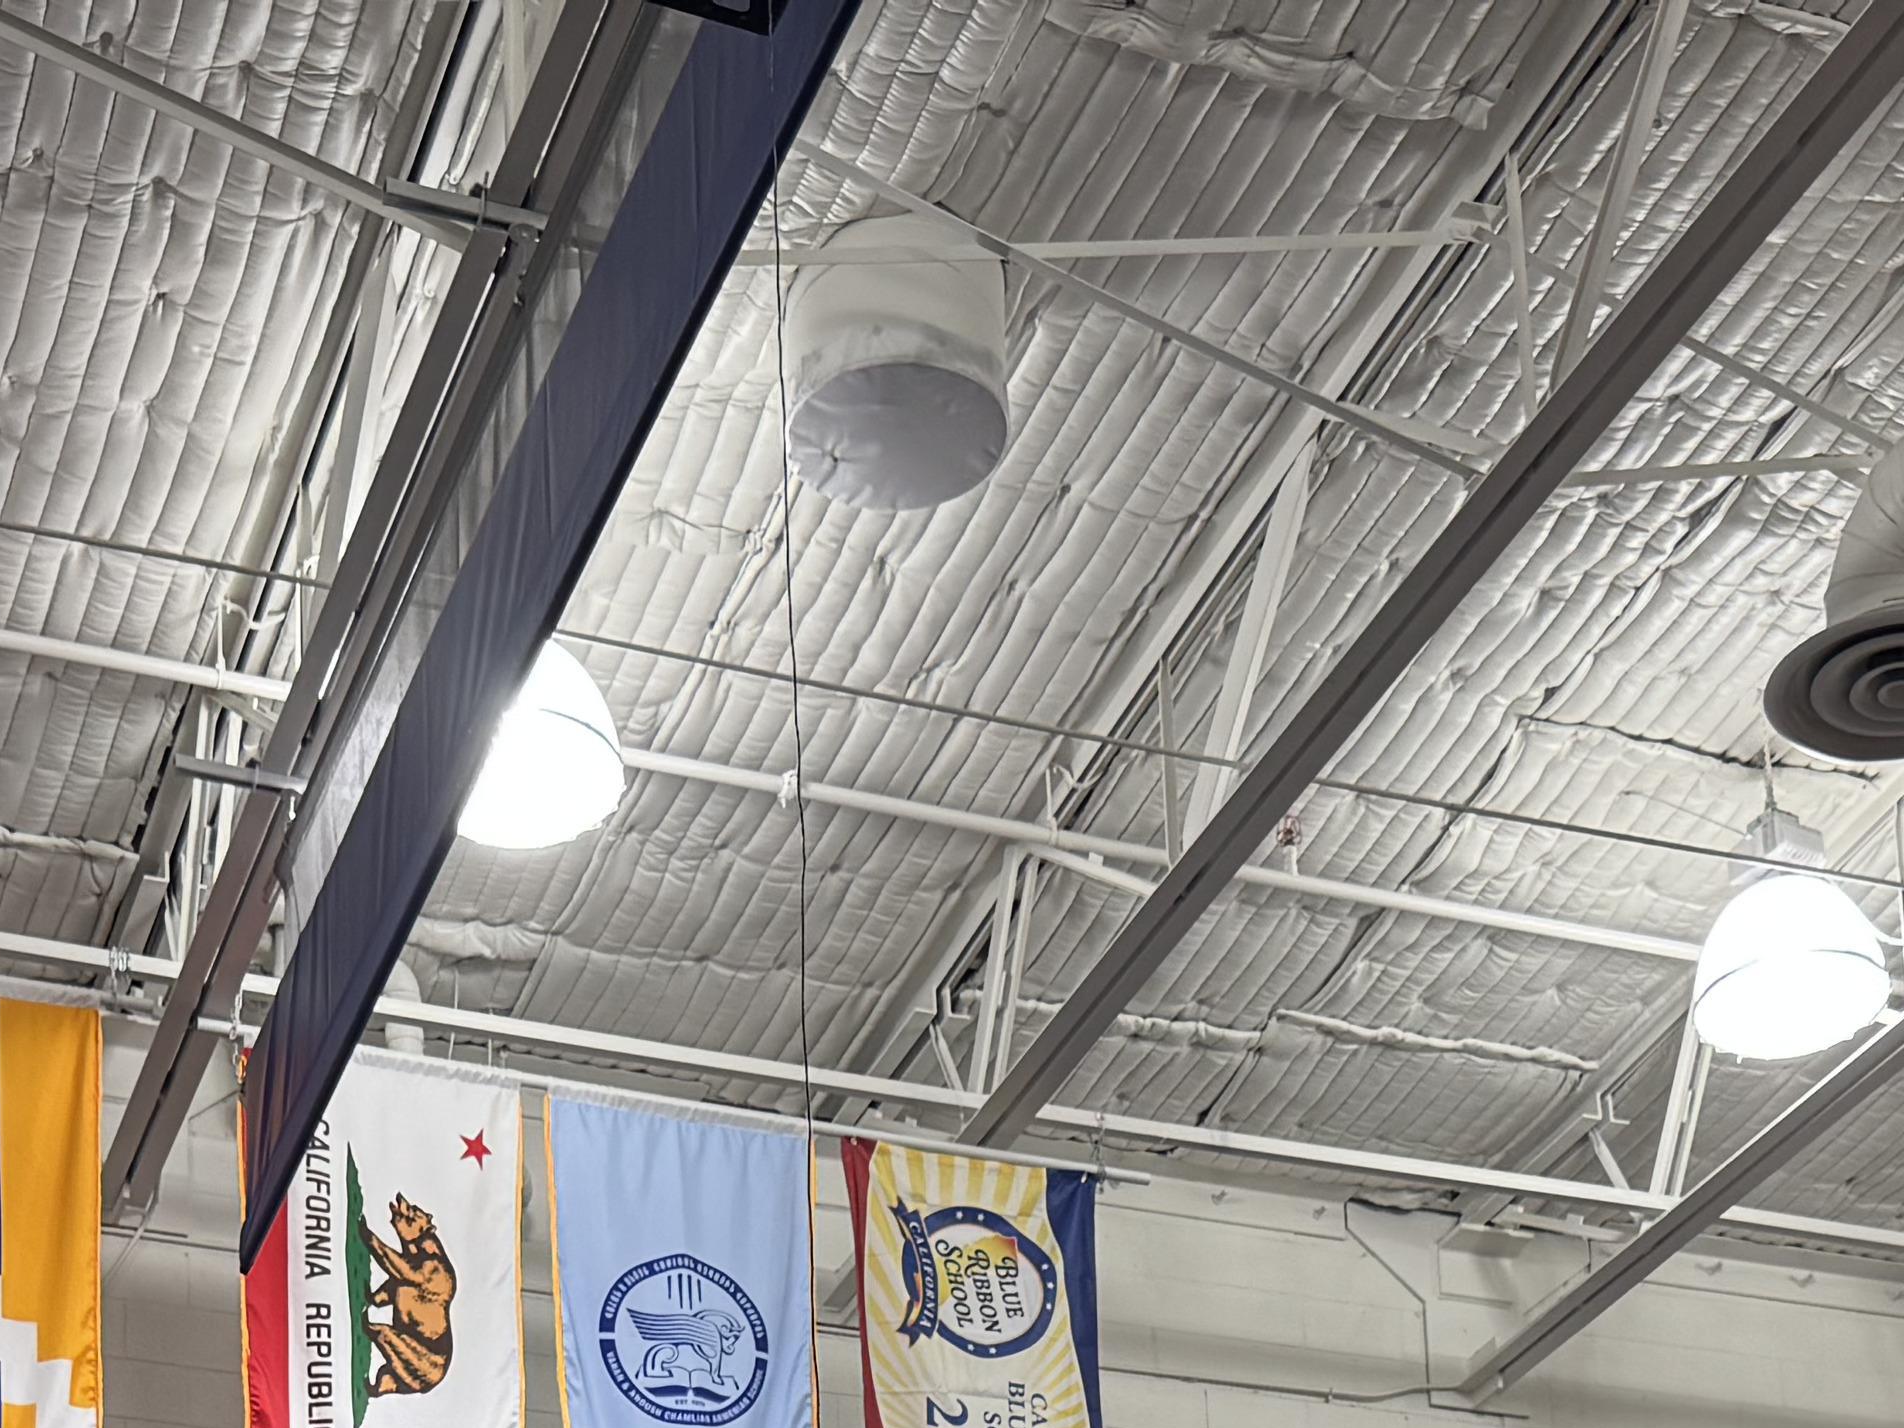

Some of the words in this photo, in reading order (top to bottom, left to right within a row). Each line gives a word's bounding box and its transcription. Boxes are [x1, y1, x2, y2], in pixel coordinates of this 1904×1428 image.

[909, 1221, 937, 1327] CALIFORNIA
[935, 1239, 973, 1328] SCHOOL
[965, 1249, 1002, 1333] RIBBON
[995, 1257, 1024, 1319] BLUE
